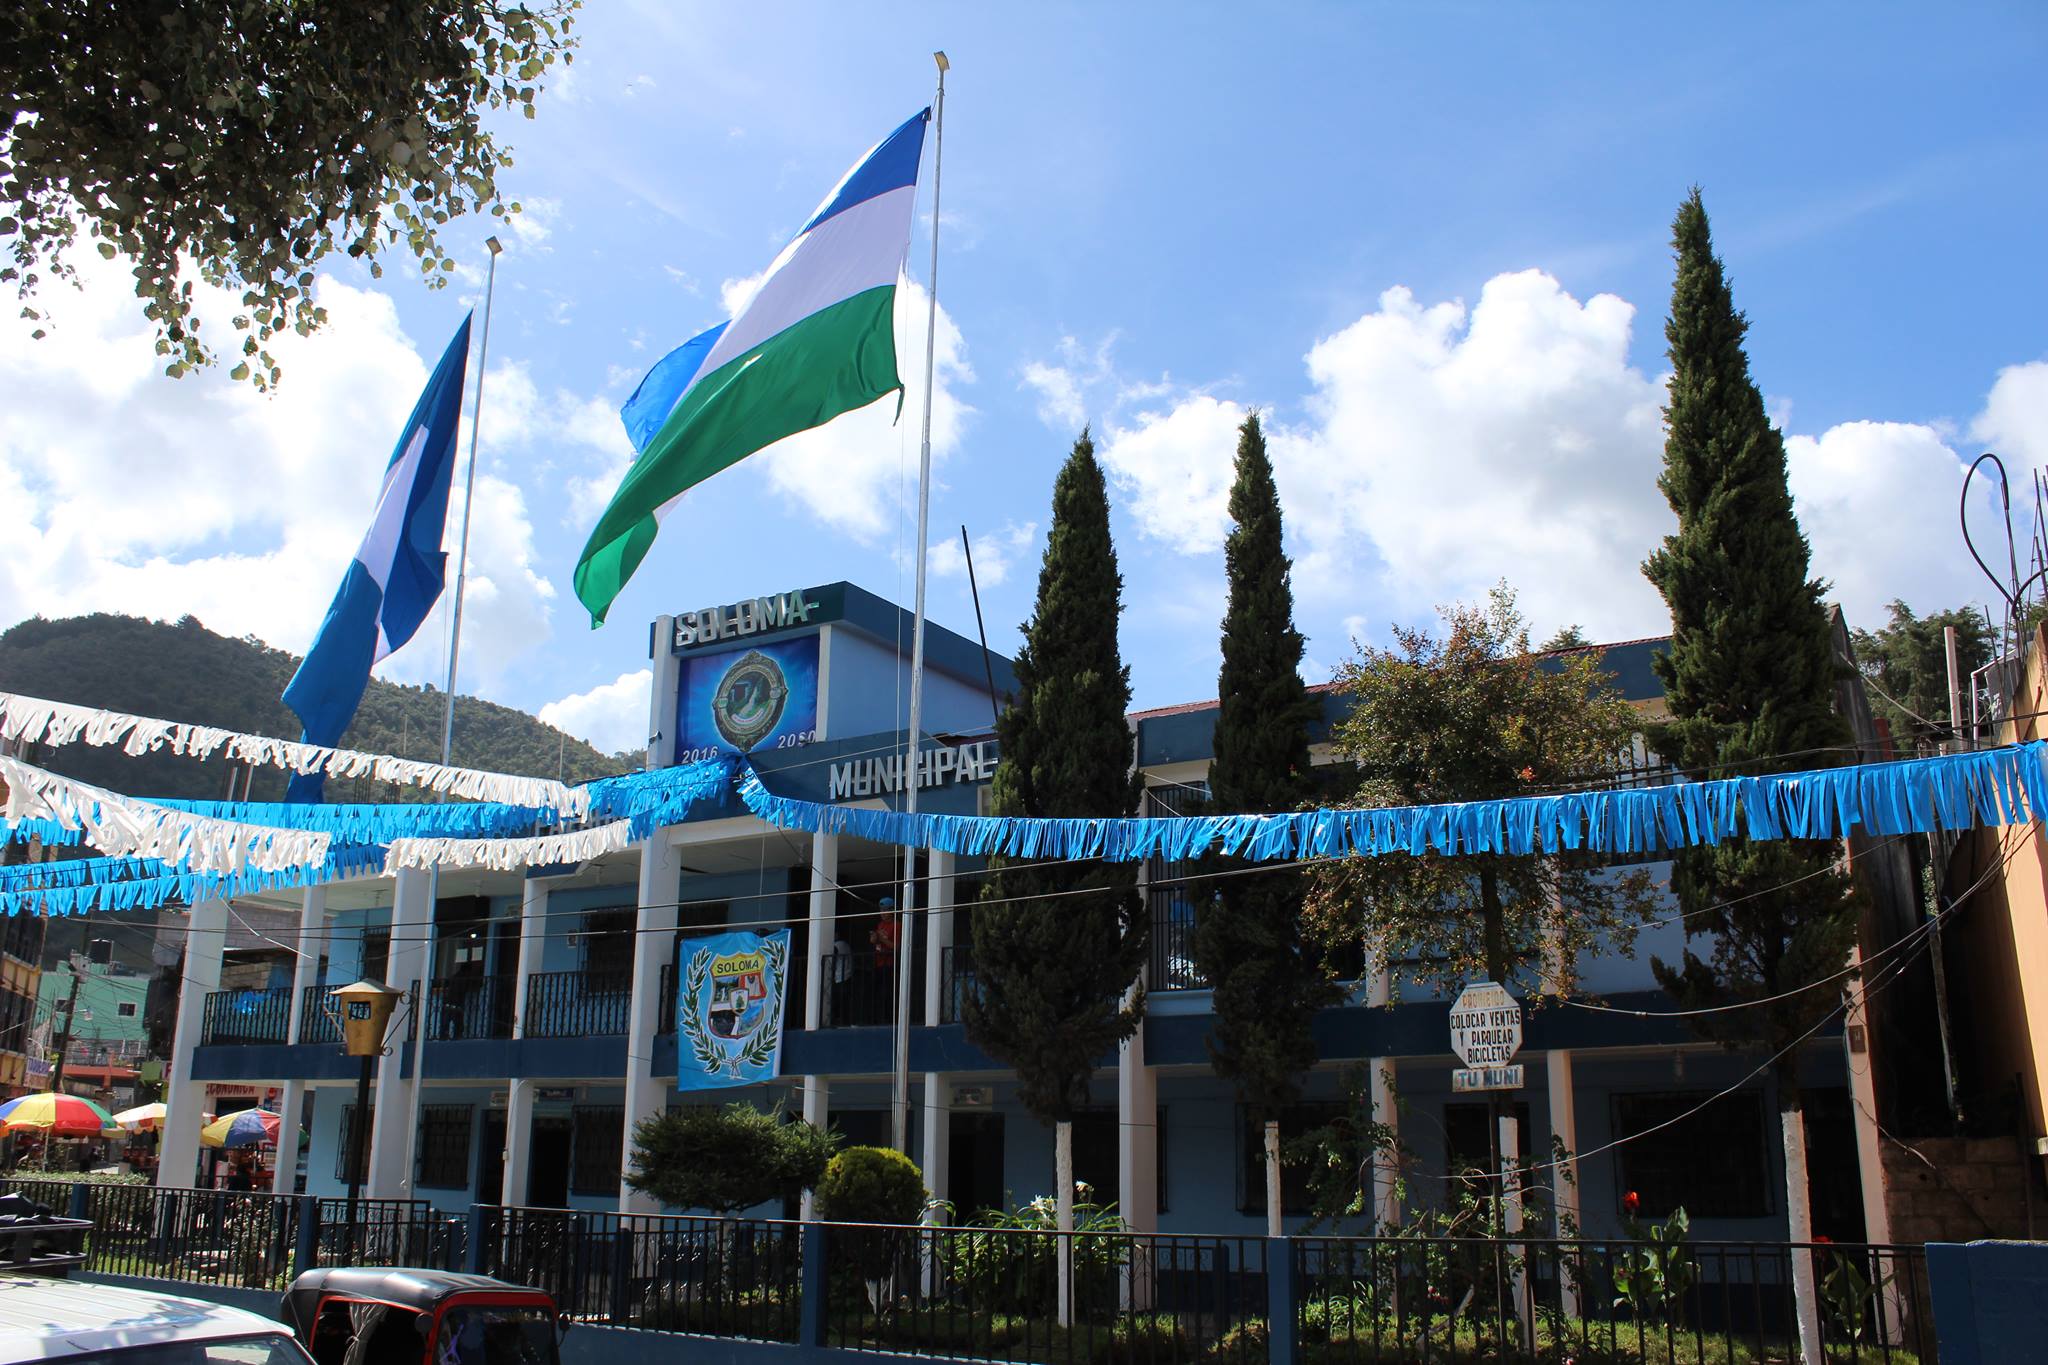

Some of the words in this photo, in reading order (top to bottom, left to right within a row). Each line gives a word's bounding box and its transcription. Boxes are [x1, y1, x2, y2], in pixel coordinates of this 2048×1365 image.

[676, 590, 808, 646] SOLOMA
[682, 746, 718, 764] 2016
[829, 742, 993, 799] MUNICIPAL
[717, 959, 759, 974] SOLOMA
[1451, 1013, 1486, 1030] COLOCAR
[1490, 1010, 1521, 1027] VENTAS
[1460, 1031, 1464, 1047] Y
[1472, 1029, 1514, 1047] PARQUEAR
[1468, 1046, 1511, 1063] BICICLETAS
[1458, 1071, 1478, 1087] TU
[1483, 1068, 1519, 1086] MUNI
